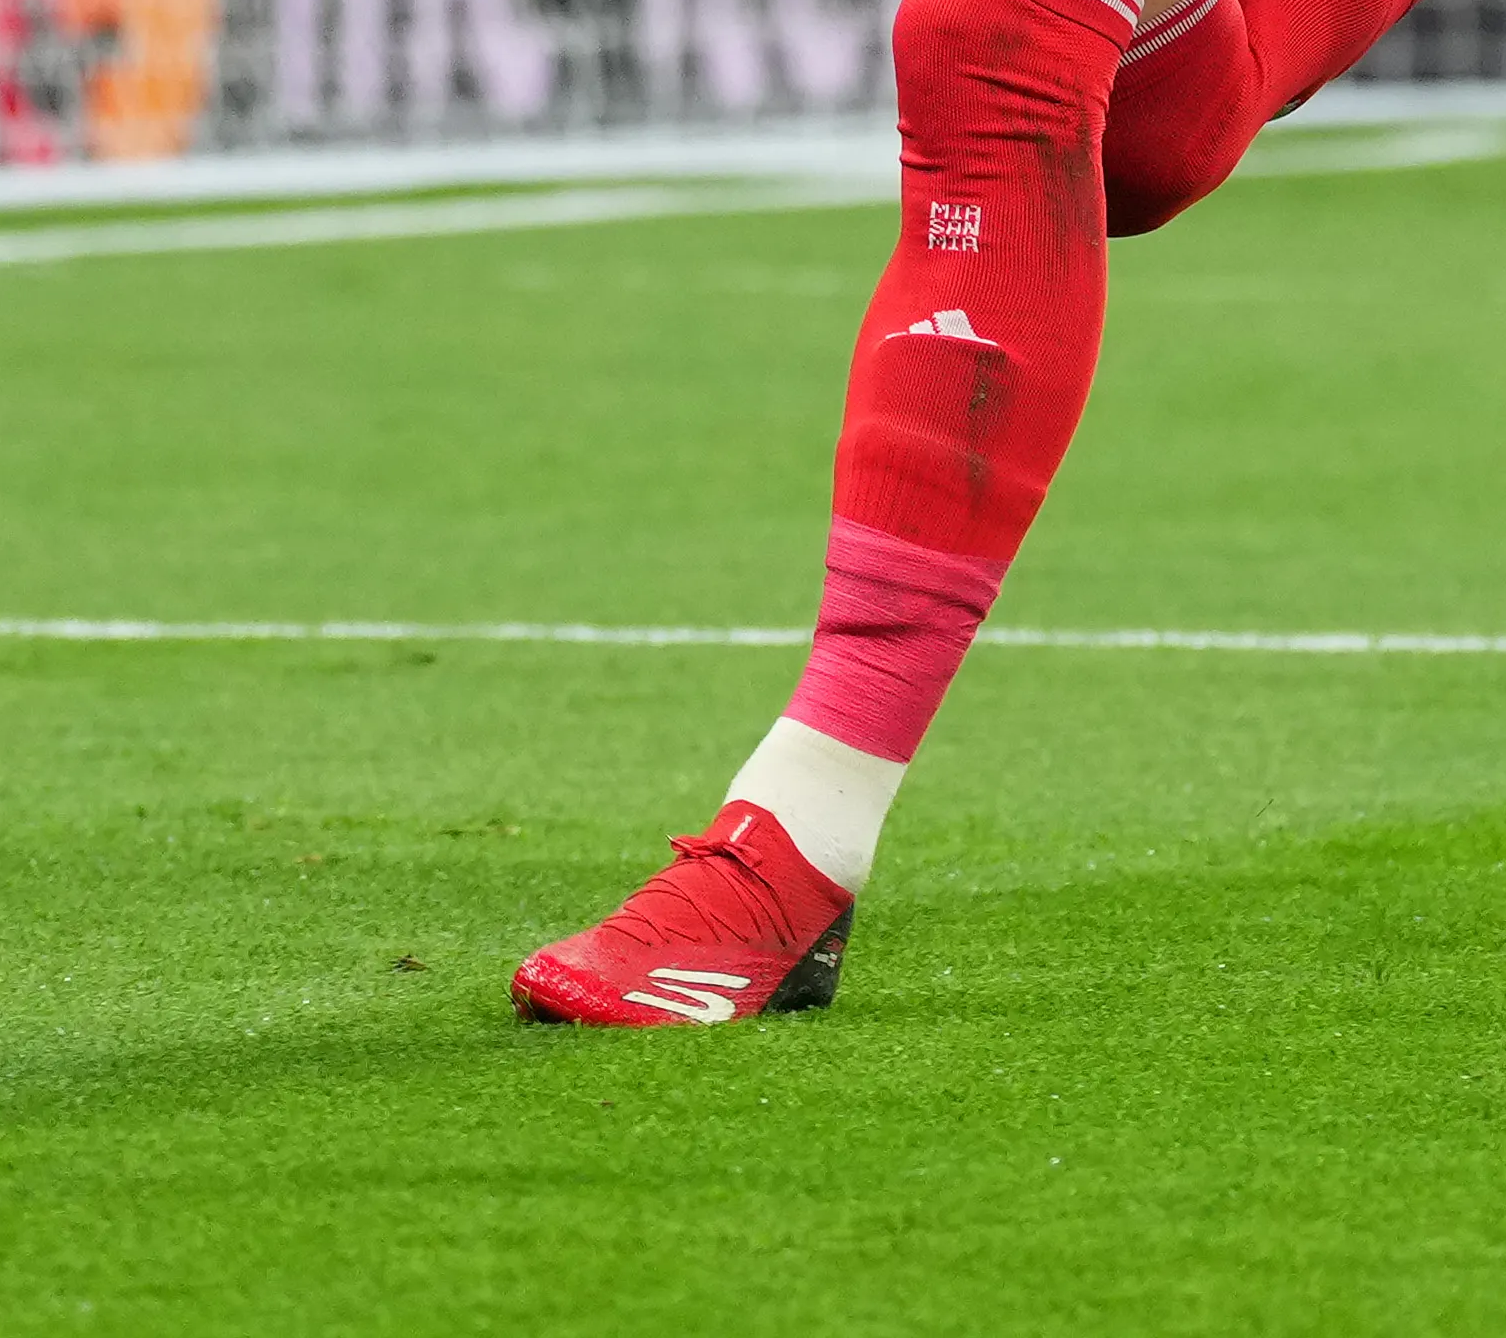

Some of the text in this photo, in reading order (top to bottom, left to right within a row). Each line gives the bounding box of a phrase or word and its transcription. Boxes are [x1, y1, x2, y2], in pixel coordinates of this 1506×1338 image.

[930, 200, 982, 221] MIA
[928, 218, 981, 237] SAN
[928, 232, 980, 254] MIA
